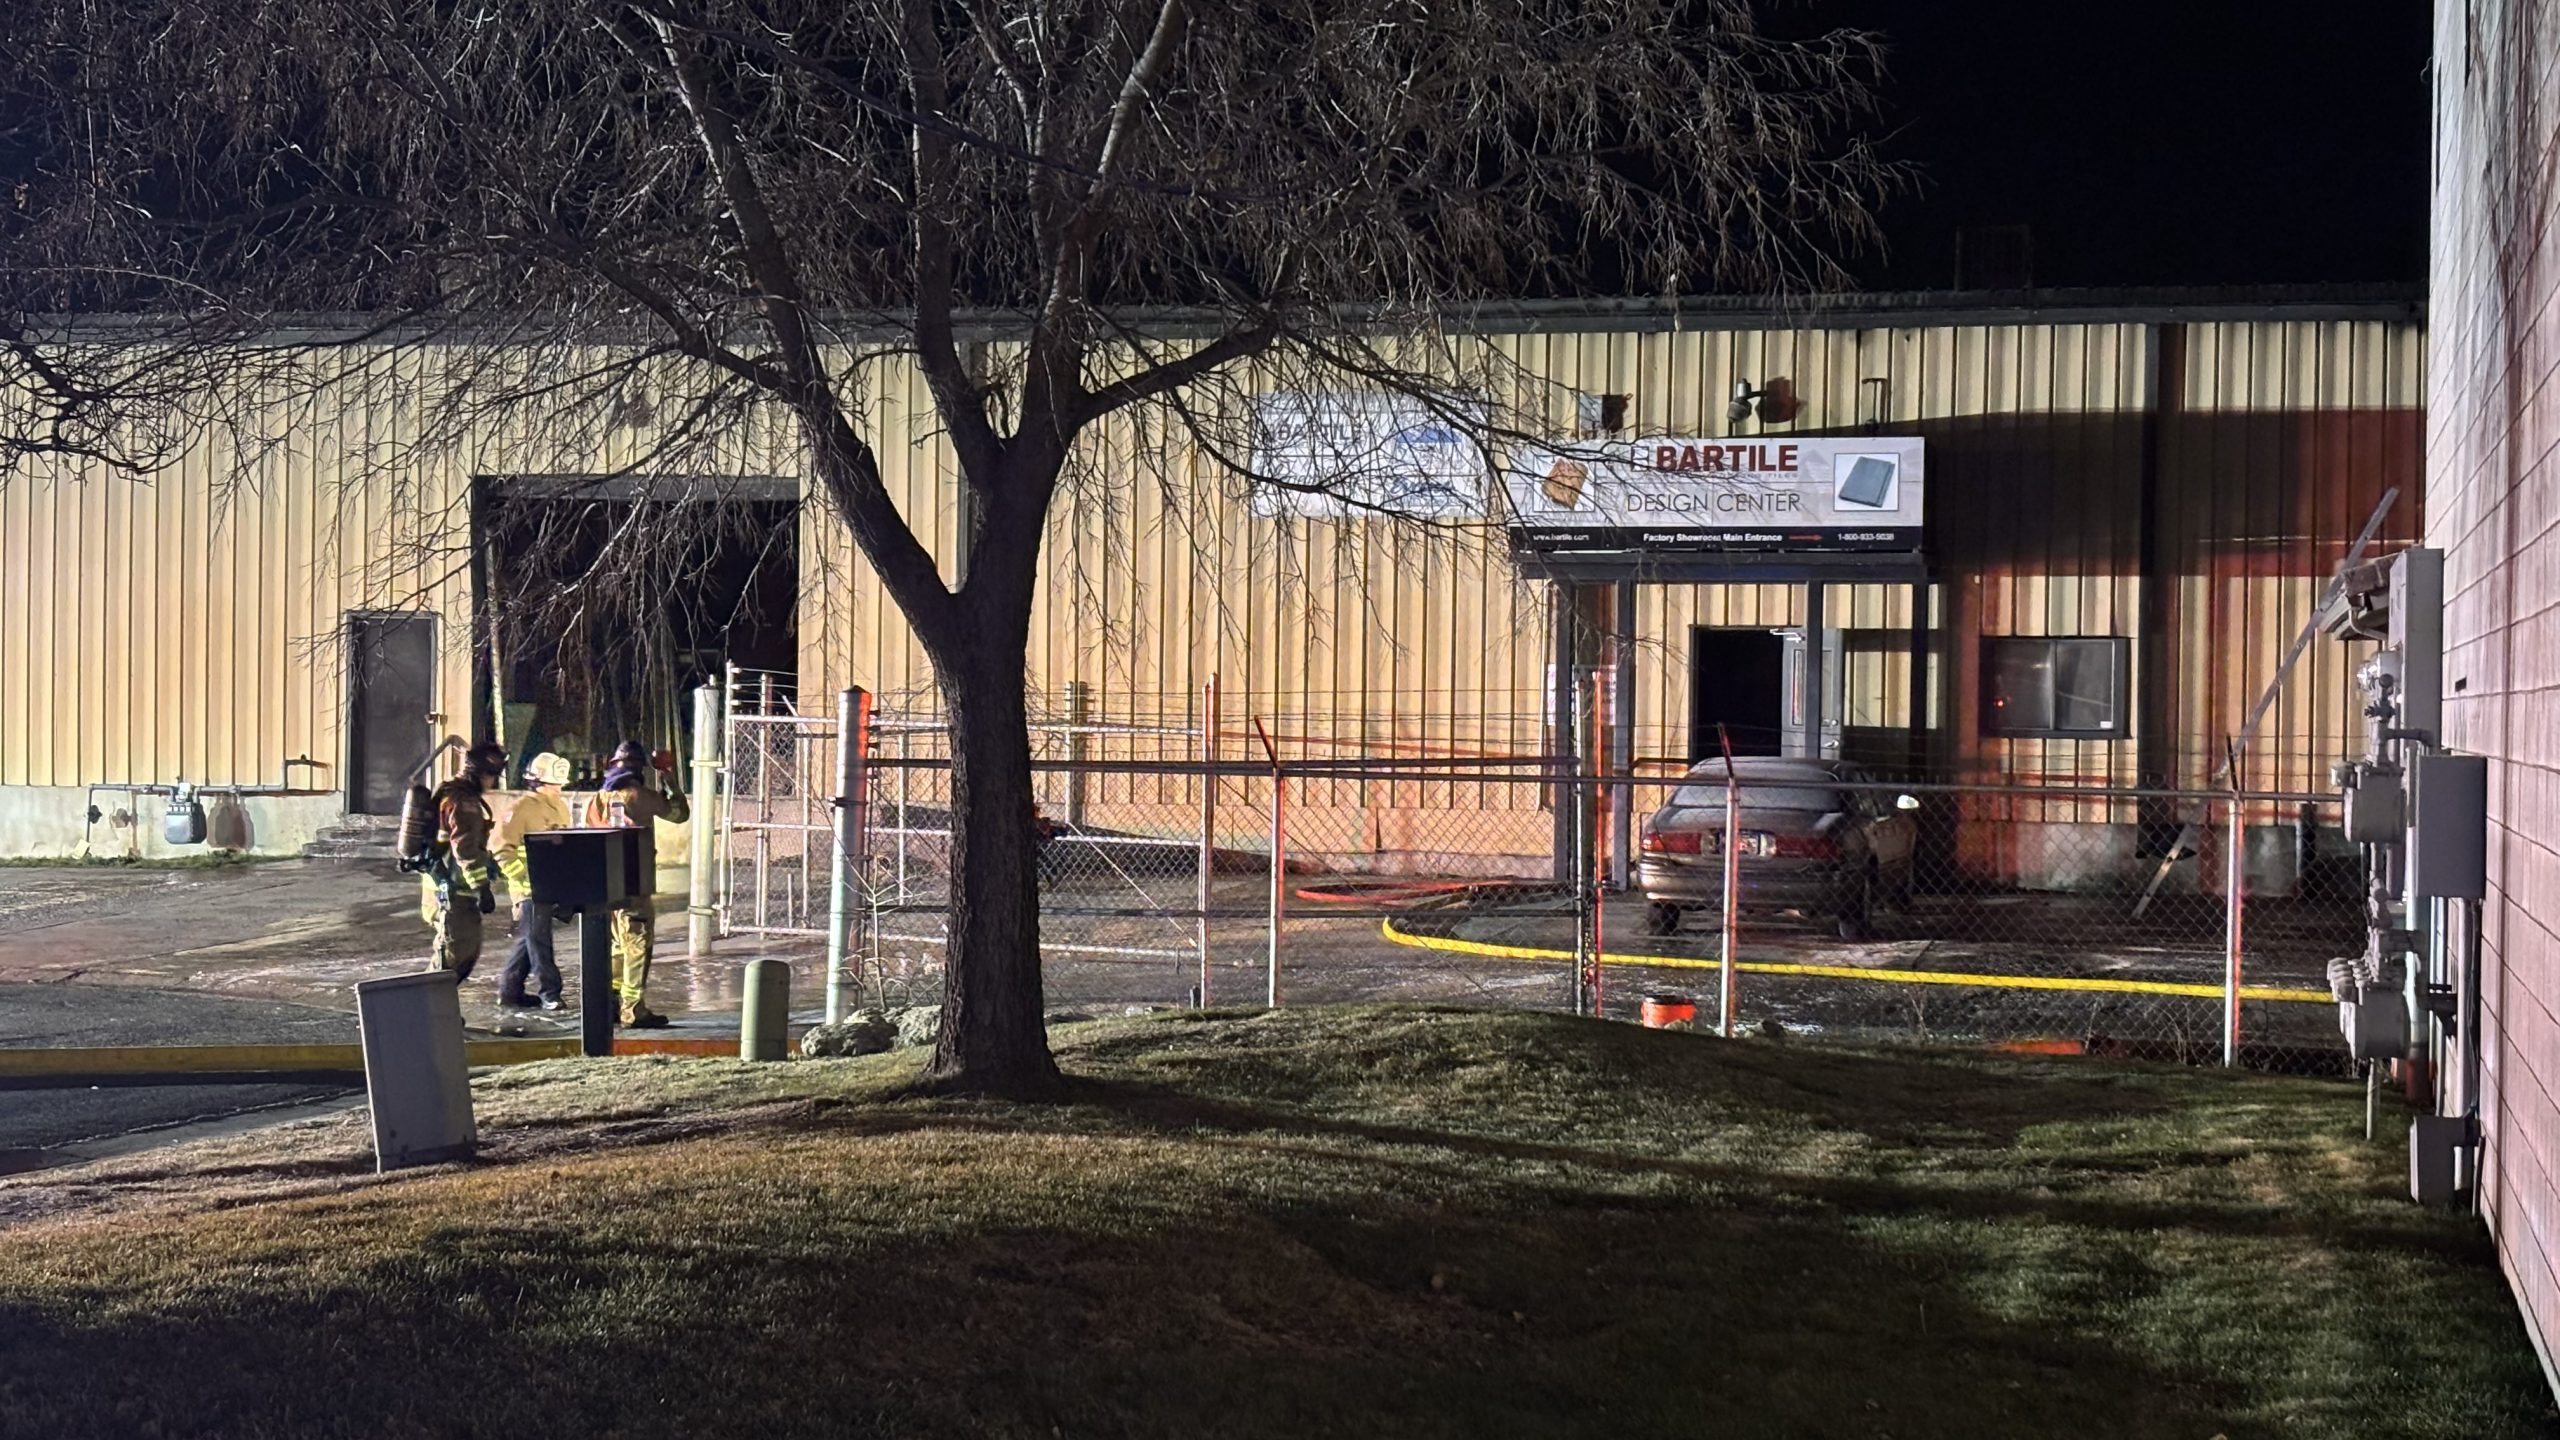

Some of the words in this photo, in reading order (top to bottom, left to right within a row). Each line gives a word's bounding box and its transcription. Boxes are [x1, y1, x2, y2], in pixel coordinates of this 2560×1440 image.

[1656, 445, 1798, 472] BARTILE
[1627, 493, 1708, 512] DESIGN
[1716, 493, 1801, 512] CENTER
[1643, 533, 1675, 543] Factory
[1723, 533, 1743, 542] Main
[1744, 533, 1783, 542] Entrance
